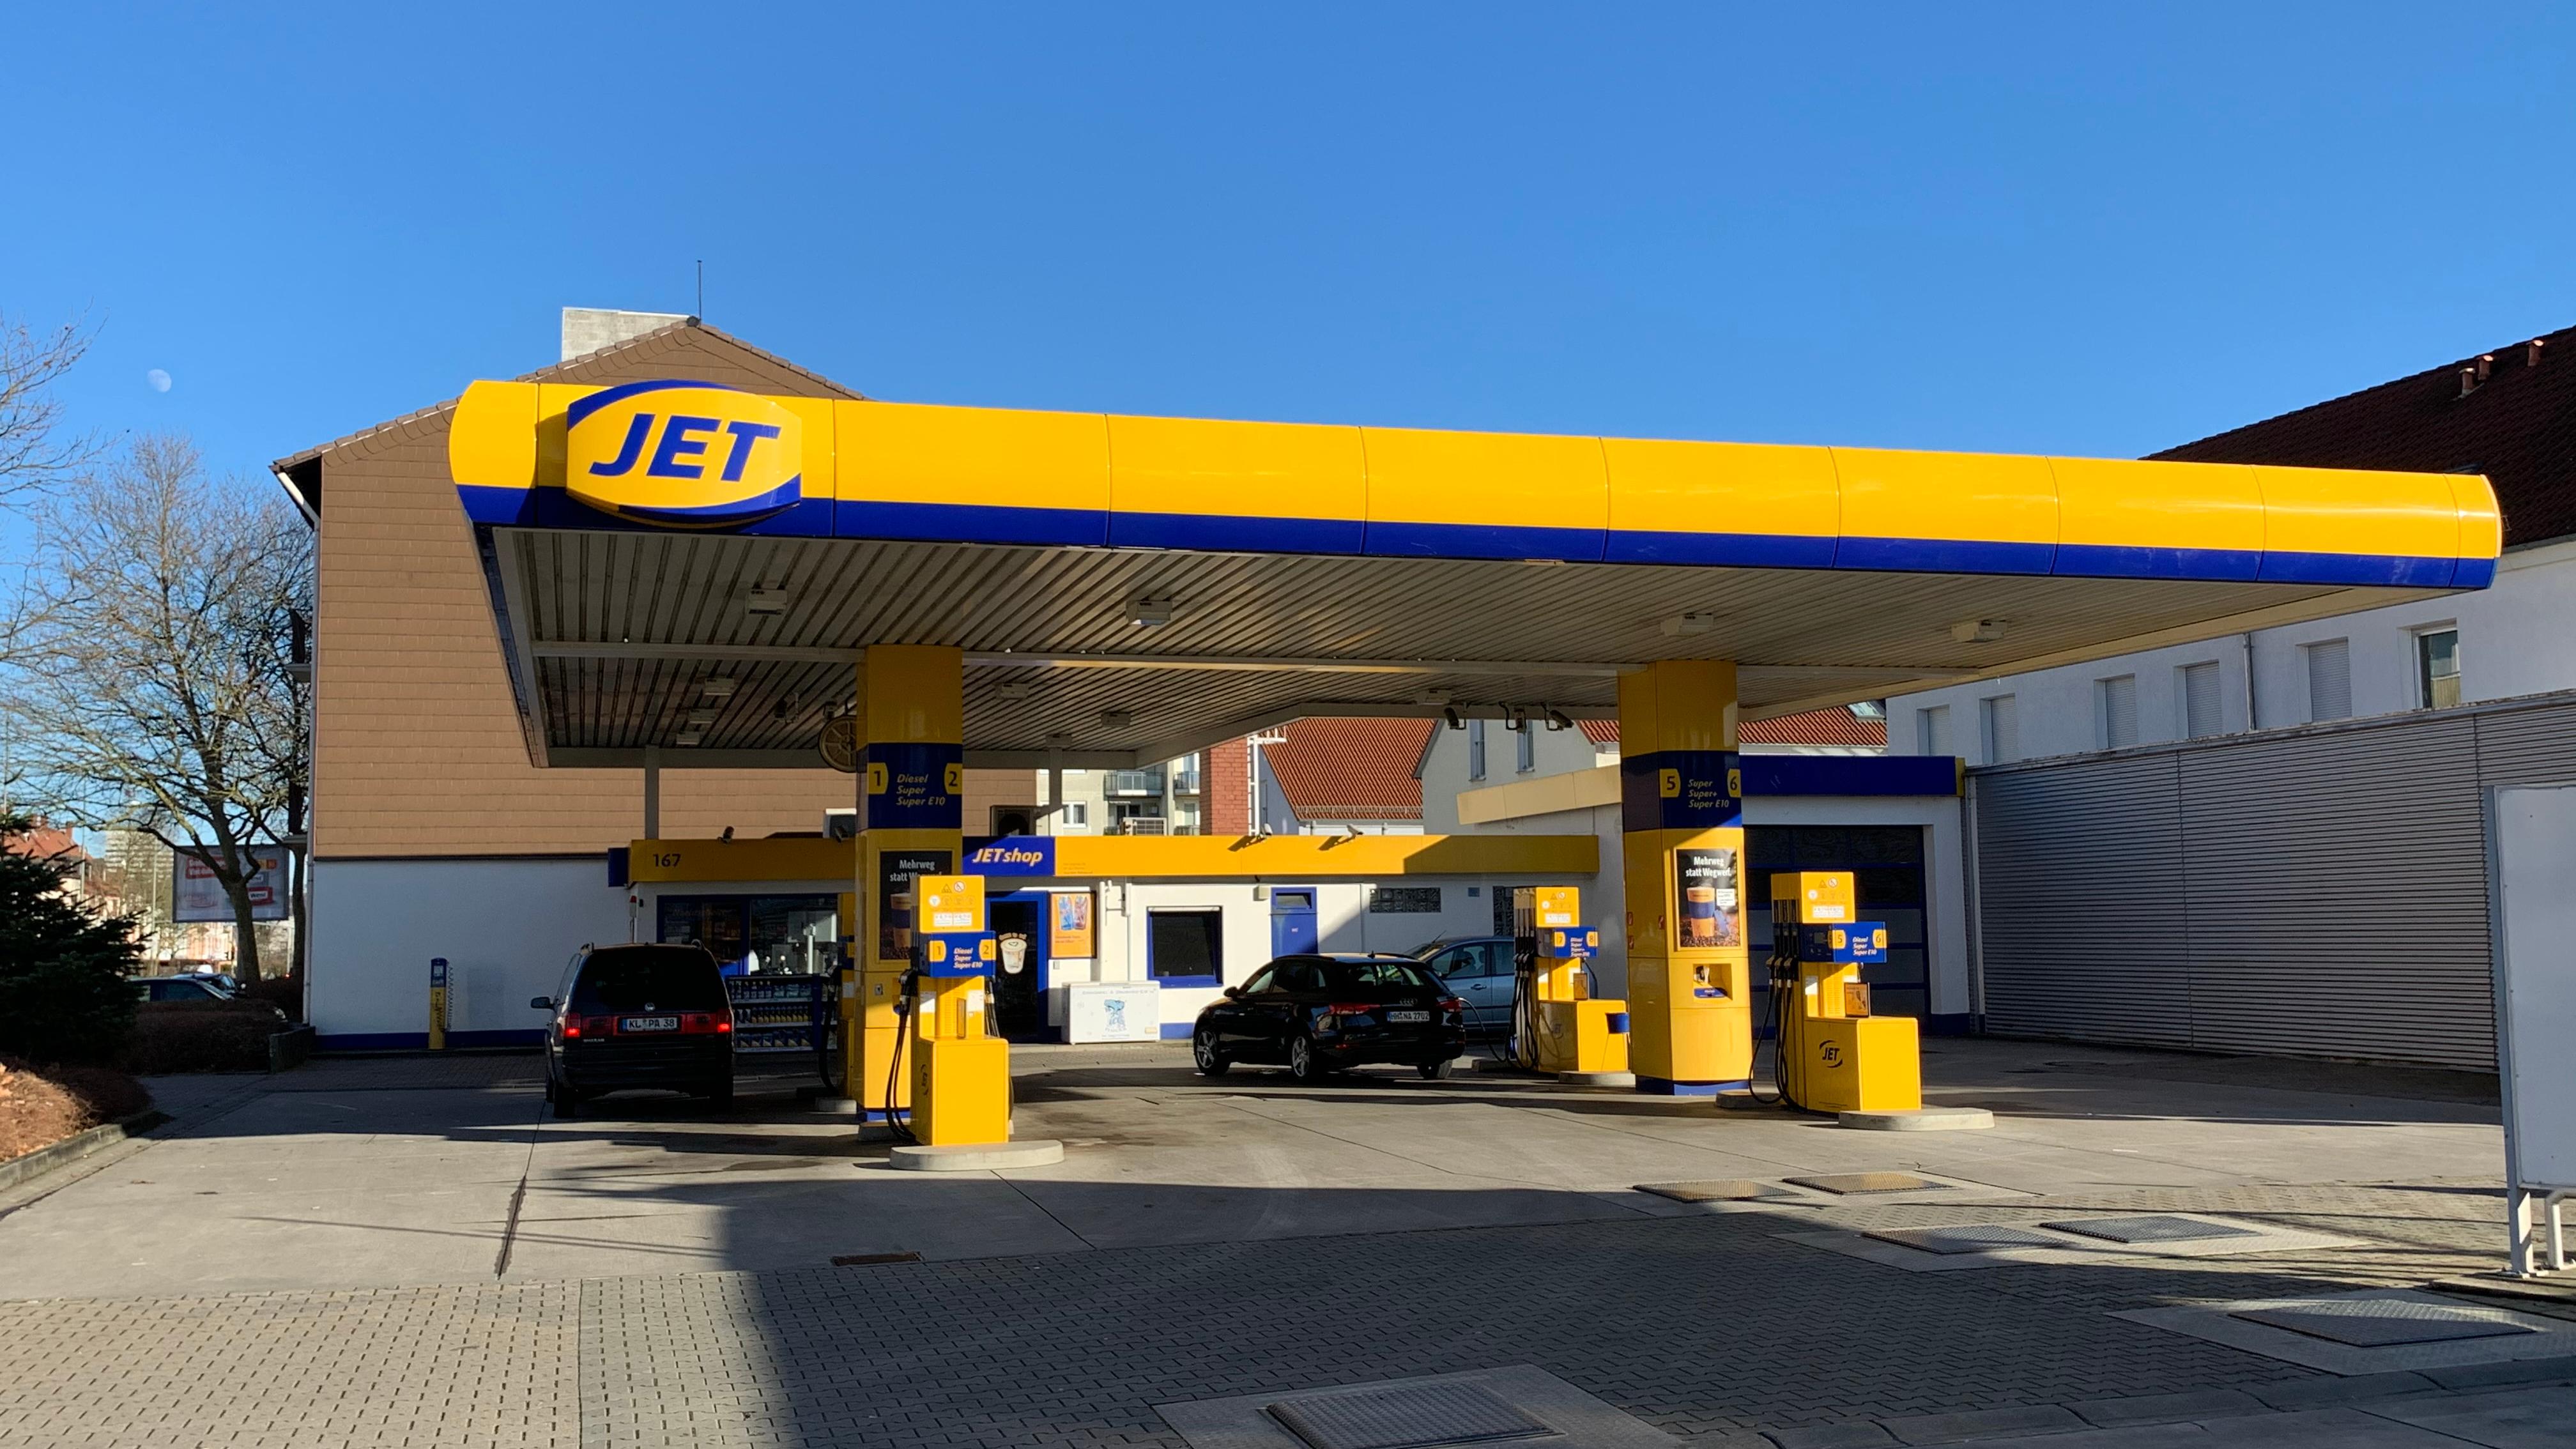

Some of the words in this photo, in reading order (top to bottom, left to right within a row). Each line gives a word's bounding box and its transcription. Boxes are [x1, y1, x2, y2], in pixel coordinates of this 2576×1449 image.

[588, 413, 781, 482] JET
[874, 770, 881, 786] 1
[896, 774, 929, 783] Diesel
[949, 771, 958, 787] 2
[1666, 776, 1676, 790] 5
[1730, 776, 1737, 790] 6
[1688, 779, 1713, 790] Super
[896, 785, 926, 796] Super
[1688, 789, 1717, 800] Super+
[896, 797, 926, 808] Super
[928, 797, 946, 806] E10
[1688, 799, 1713, 810] Super
[1715, 799, 1729, 808] E10
[653, 853, 682, 868] 167
[899, 859, 935, 870] Mehrweg
[1694, 856, 1724, 866] Mehrweg
[889, 872, 908, 882] statt
[1685, 869, 1702, 877] statt
[1837, 934, 1843, 943] 5
[1876, 934, 1881, 943] 6
[937, 946, 941, 955] 1
[983, 945, 989, 954] 2
[1391, 1012, 1399, 1020] HH
[648, 1019, 660, 1027] PA
[664, 1019, 675, 1027] 38
[1821, 1047, 1840, 1061] JET
